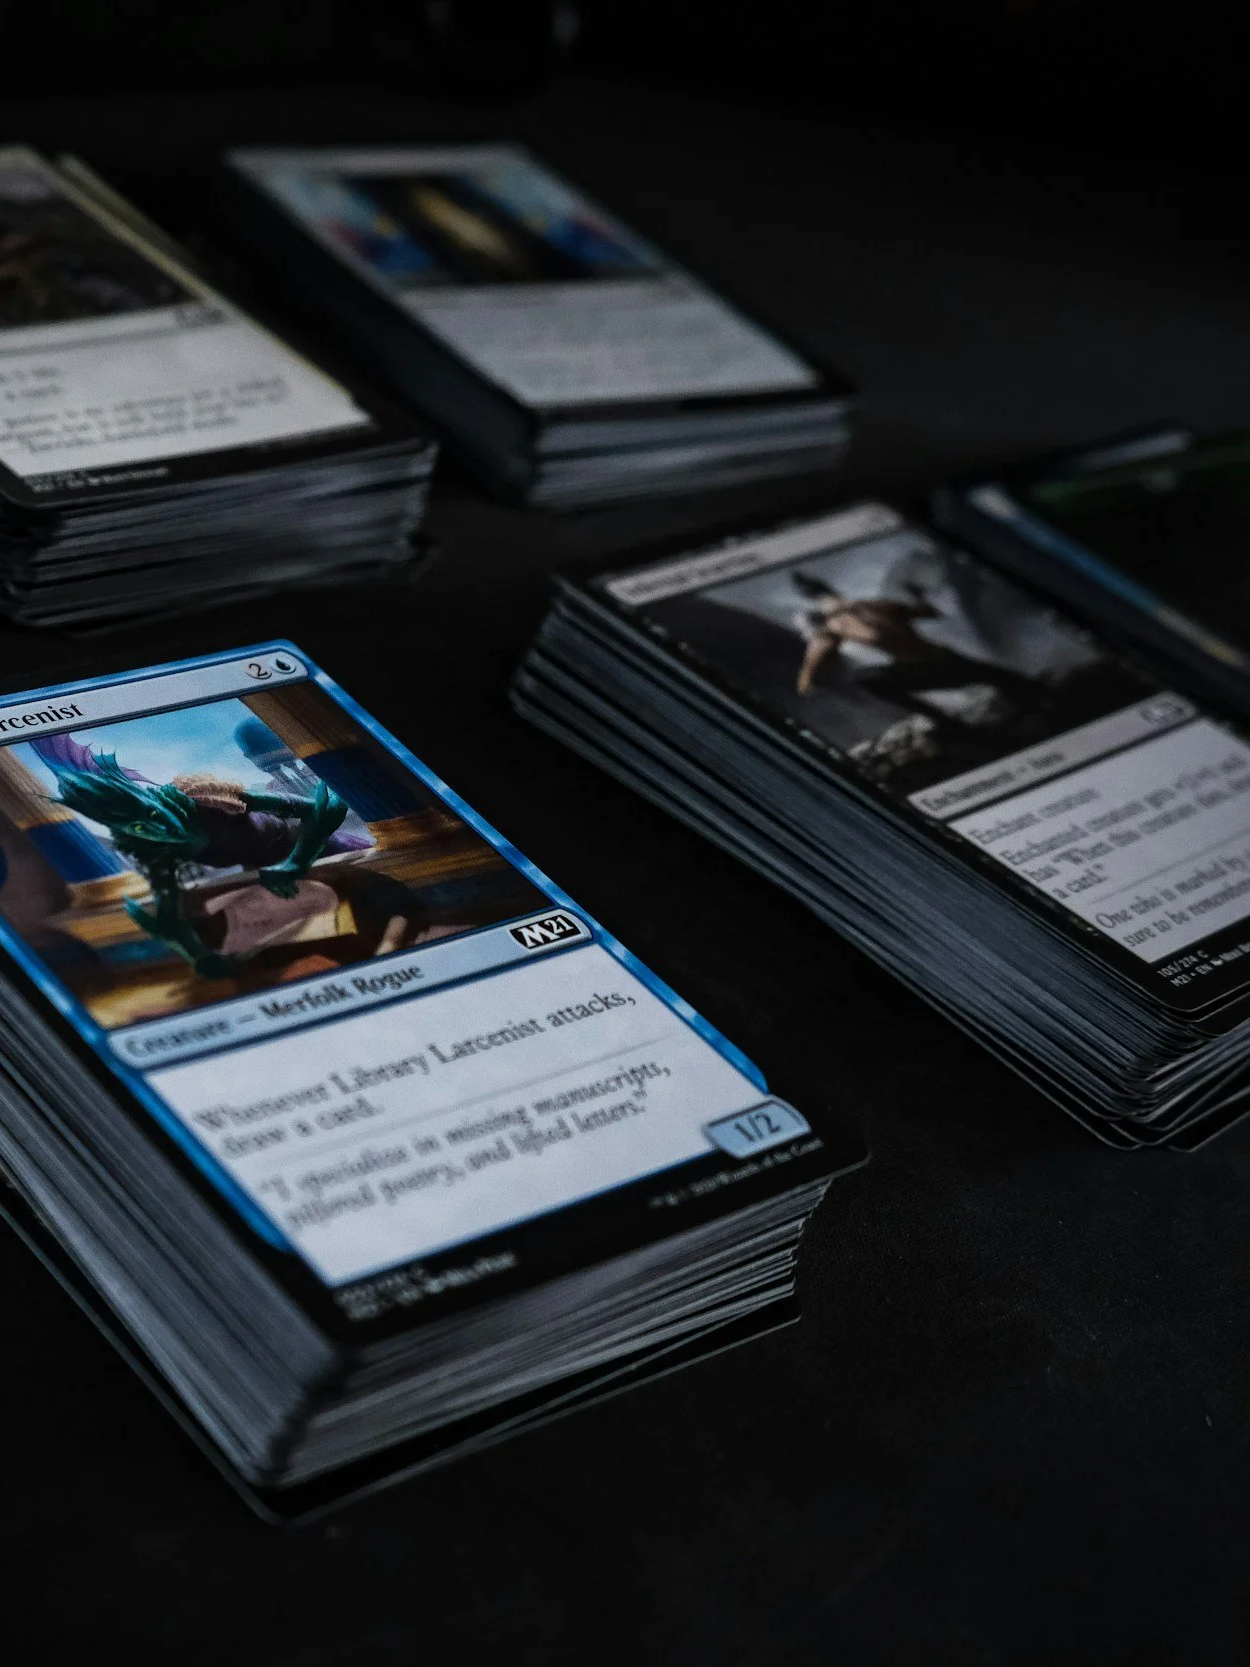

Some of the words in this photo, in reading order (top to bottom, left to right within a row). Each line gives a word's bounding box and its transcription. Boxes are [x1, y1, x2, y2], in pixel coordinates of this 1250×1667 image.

[248, 663, 269, 678] 2
[514, 915, 576, 948] M21
[1095, 909, 1132, 929] One
[1122, 926, 1157, 948] sure
[125, 1018, 230, 1057] Creature
[258, 984, 354, 1019] Merfolk
[352, 964, 426, 995] Rogue
[193, 1082, 330, 1131] Whenever
[329, 1053, 431, 1095] Library
[427, 1018, 547, 1064] Larcenist
[546, 991, 637, 1028] attacks,
[531, 1060, 672, 1116] manuscripts,
[316, 1095, 384, 1130] card.
[734, 1111, 781, 1143] 1/2
